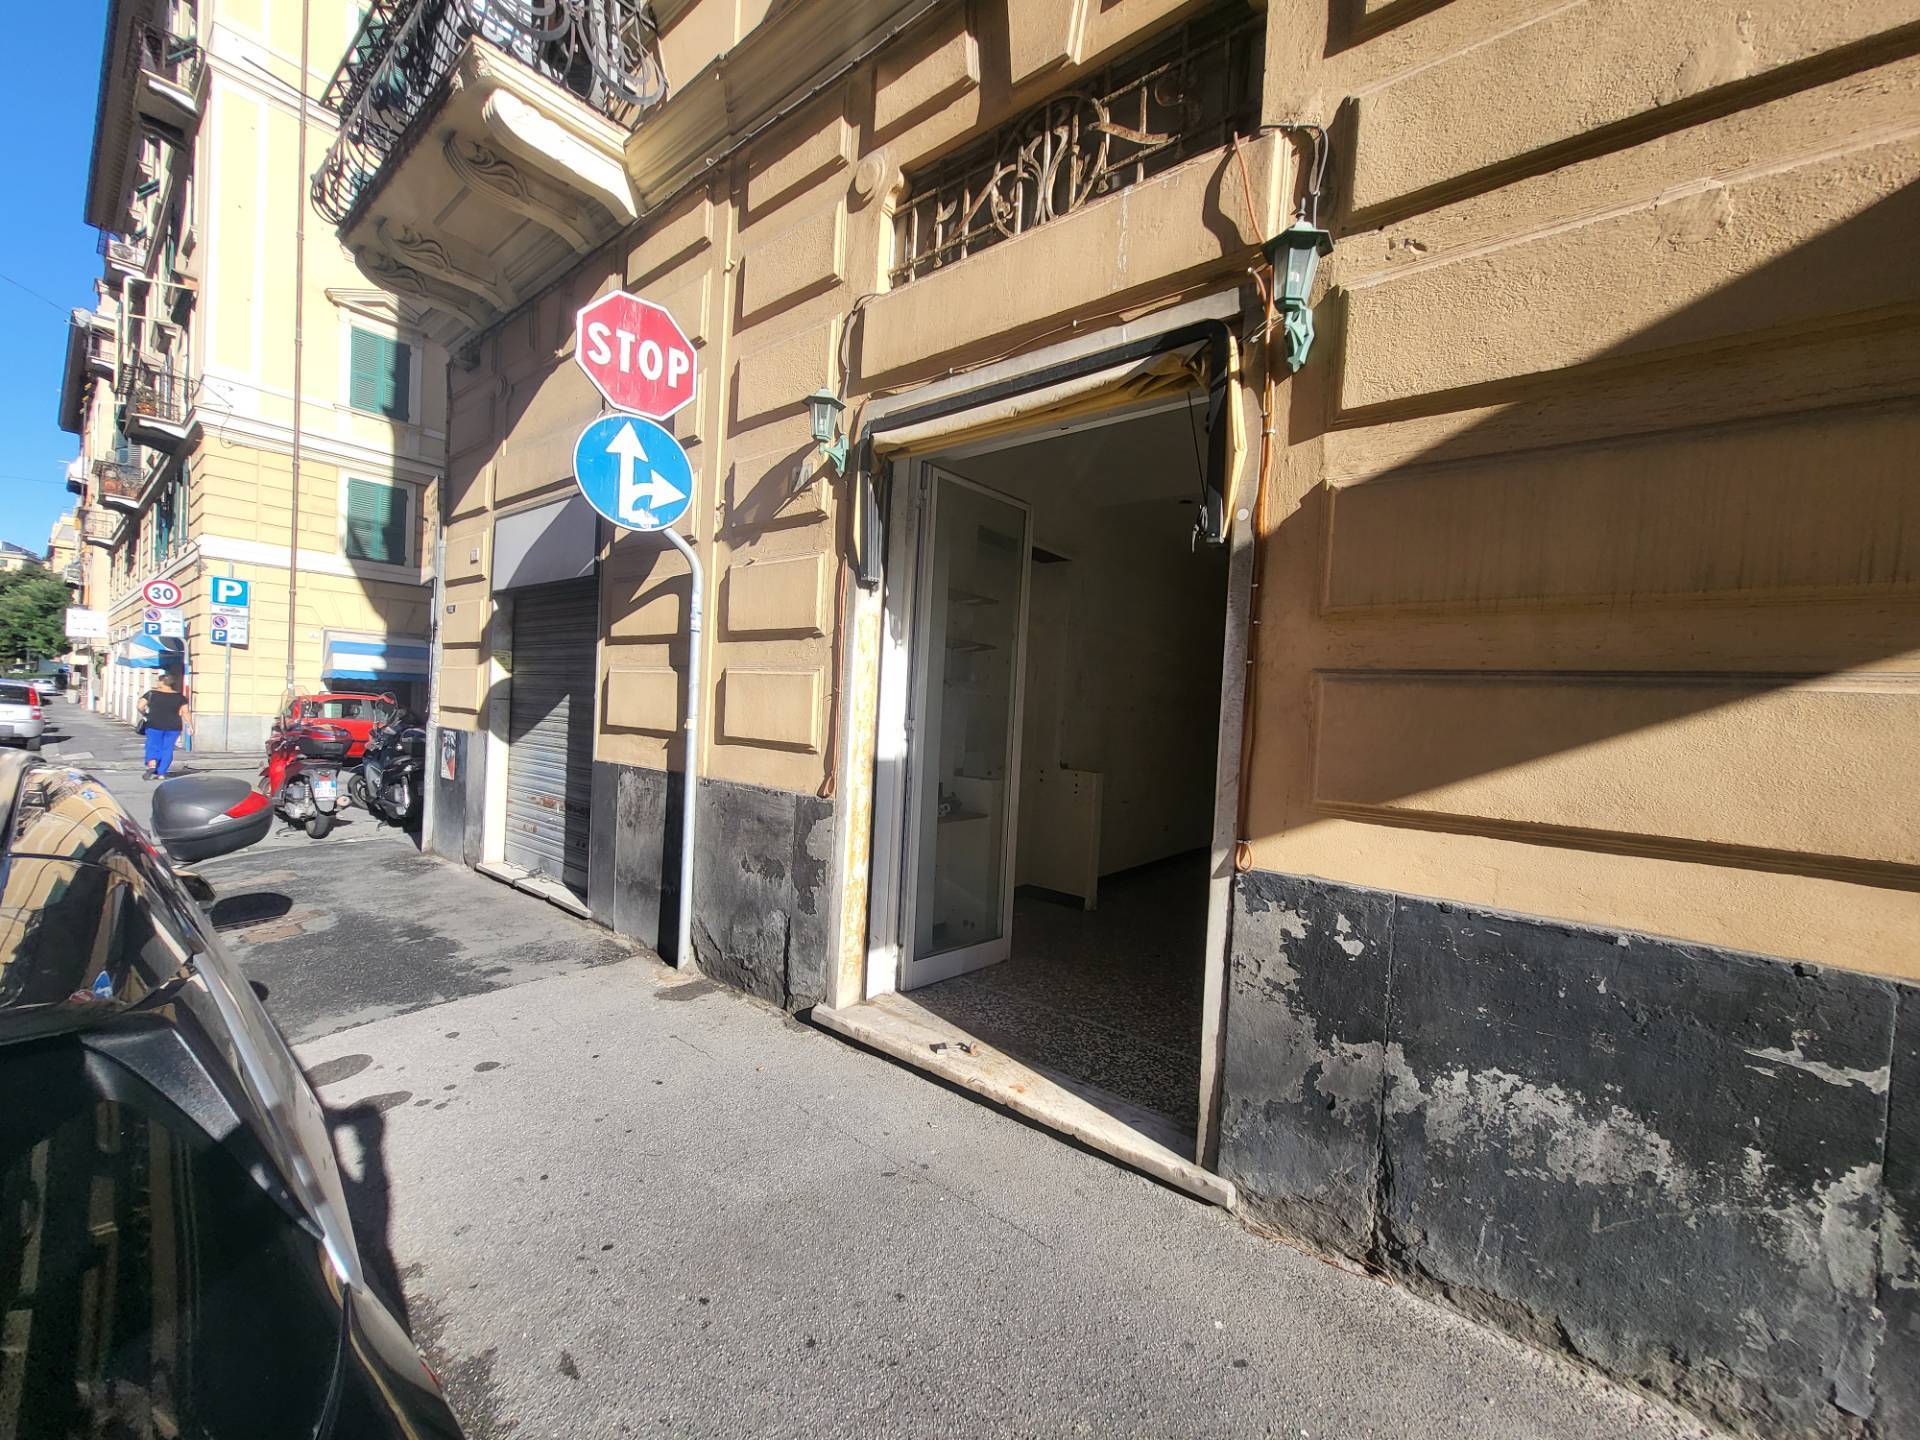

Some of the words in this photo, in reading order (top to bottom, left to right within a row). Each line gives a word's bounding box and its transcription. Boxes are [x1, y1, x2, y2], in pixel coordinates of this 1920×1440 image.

[587, 321, 690, 389] STOP
[151, 586, 174, 601] 30
[217, 579, 243, 603] P
[147, 623, 159, 634] P
[215, 630, 226, 641] P
